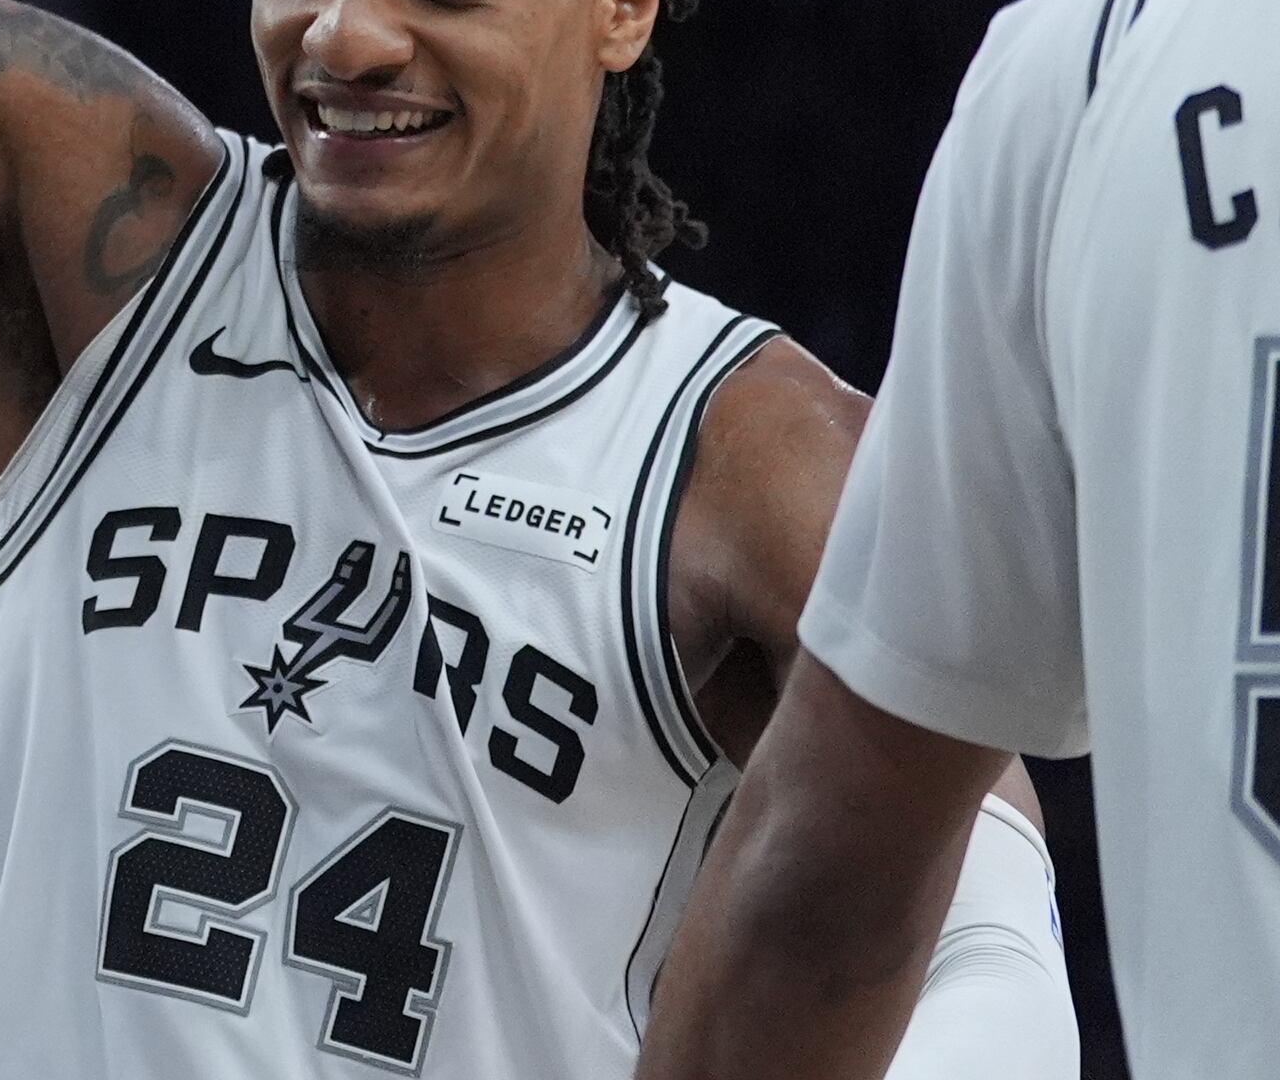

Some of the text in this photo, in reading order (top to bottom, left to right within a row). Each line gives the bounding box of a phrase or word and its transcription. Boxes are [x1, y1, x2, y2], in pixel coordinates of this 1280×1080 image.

[82, 506, 599, 804] SPURS
[464, 489, 586, 540] LEDGER
[95, 737, 464, 1078] 24
